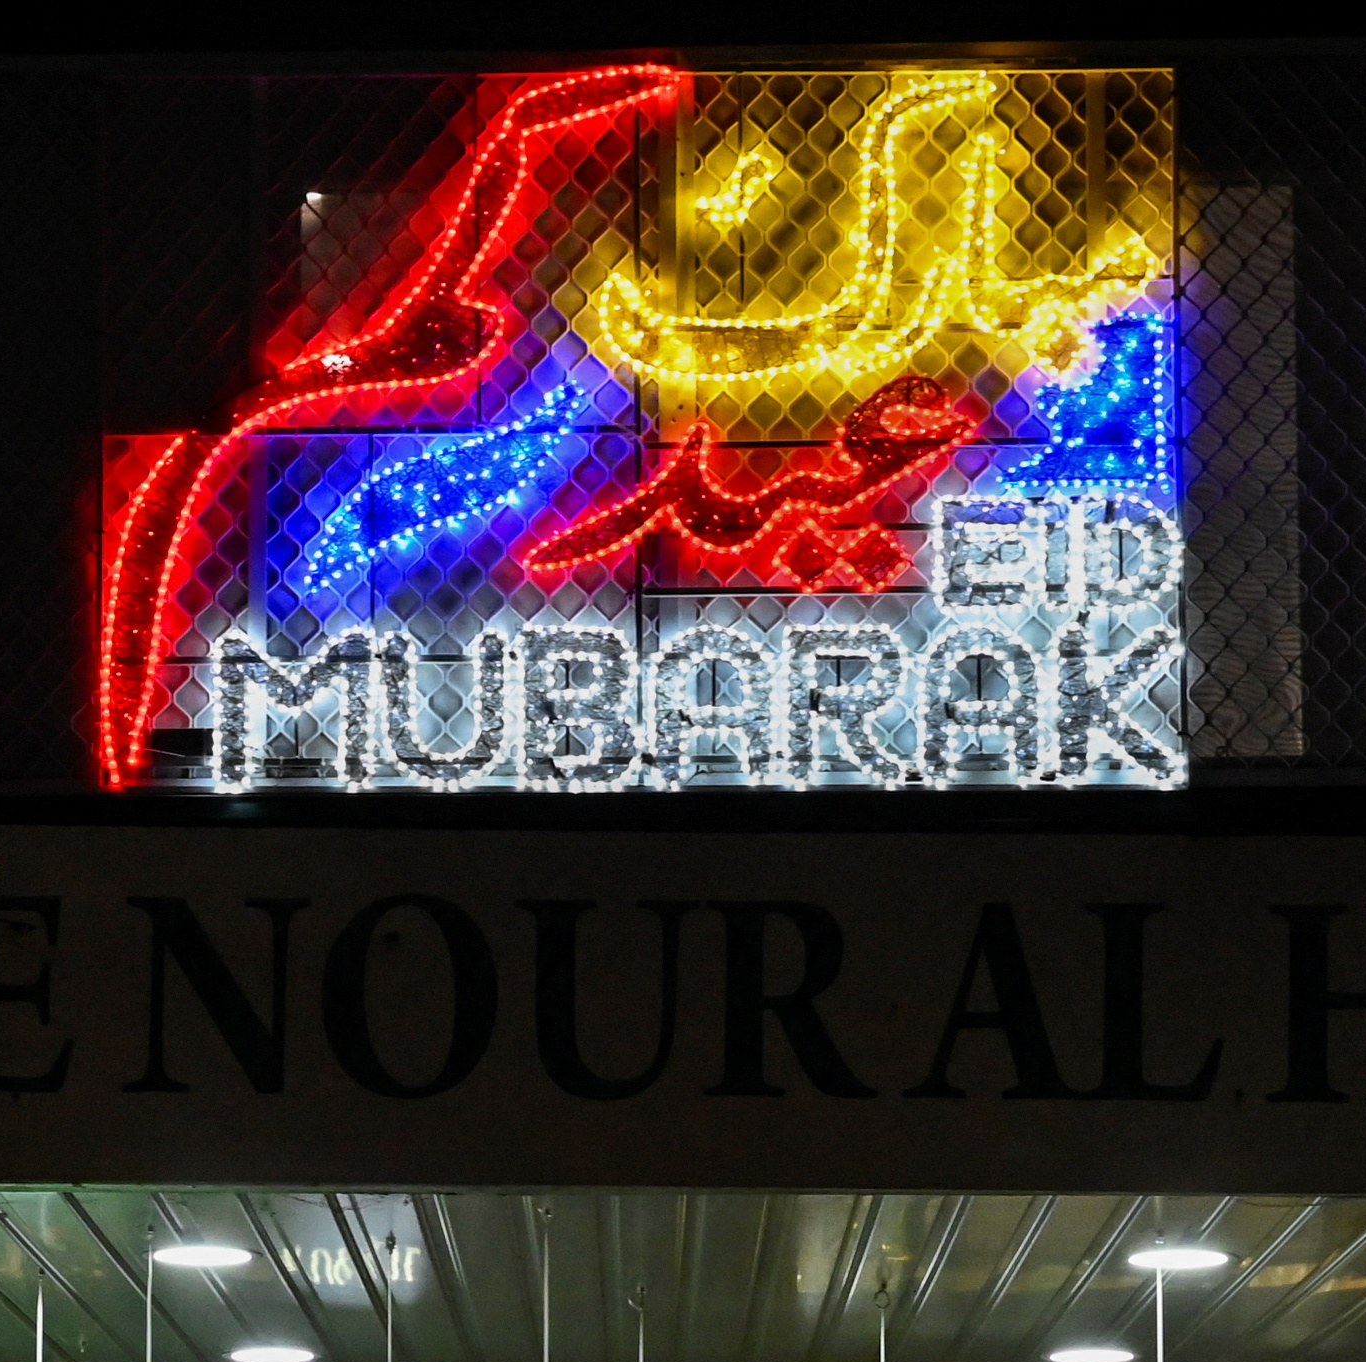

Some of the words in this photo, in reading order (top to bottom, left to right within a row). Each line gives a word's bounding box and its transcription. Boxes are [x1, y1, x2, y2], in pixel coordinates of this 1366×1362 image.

[929, 490, 1185, 610] EID
[209, 624, 1189, 792] MUBARAK
[121, 893, 879, 1101] NOUR
[903, 901, 1225, 1102] AL
